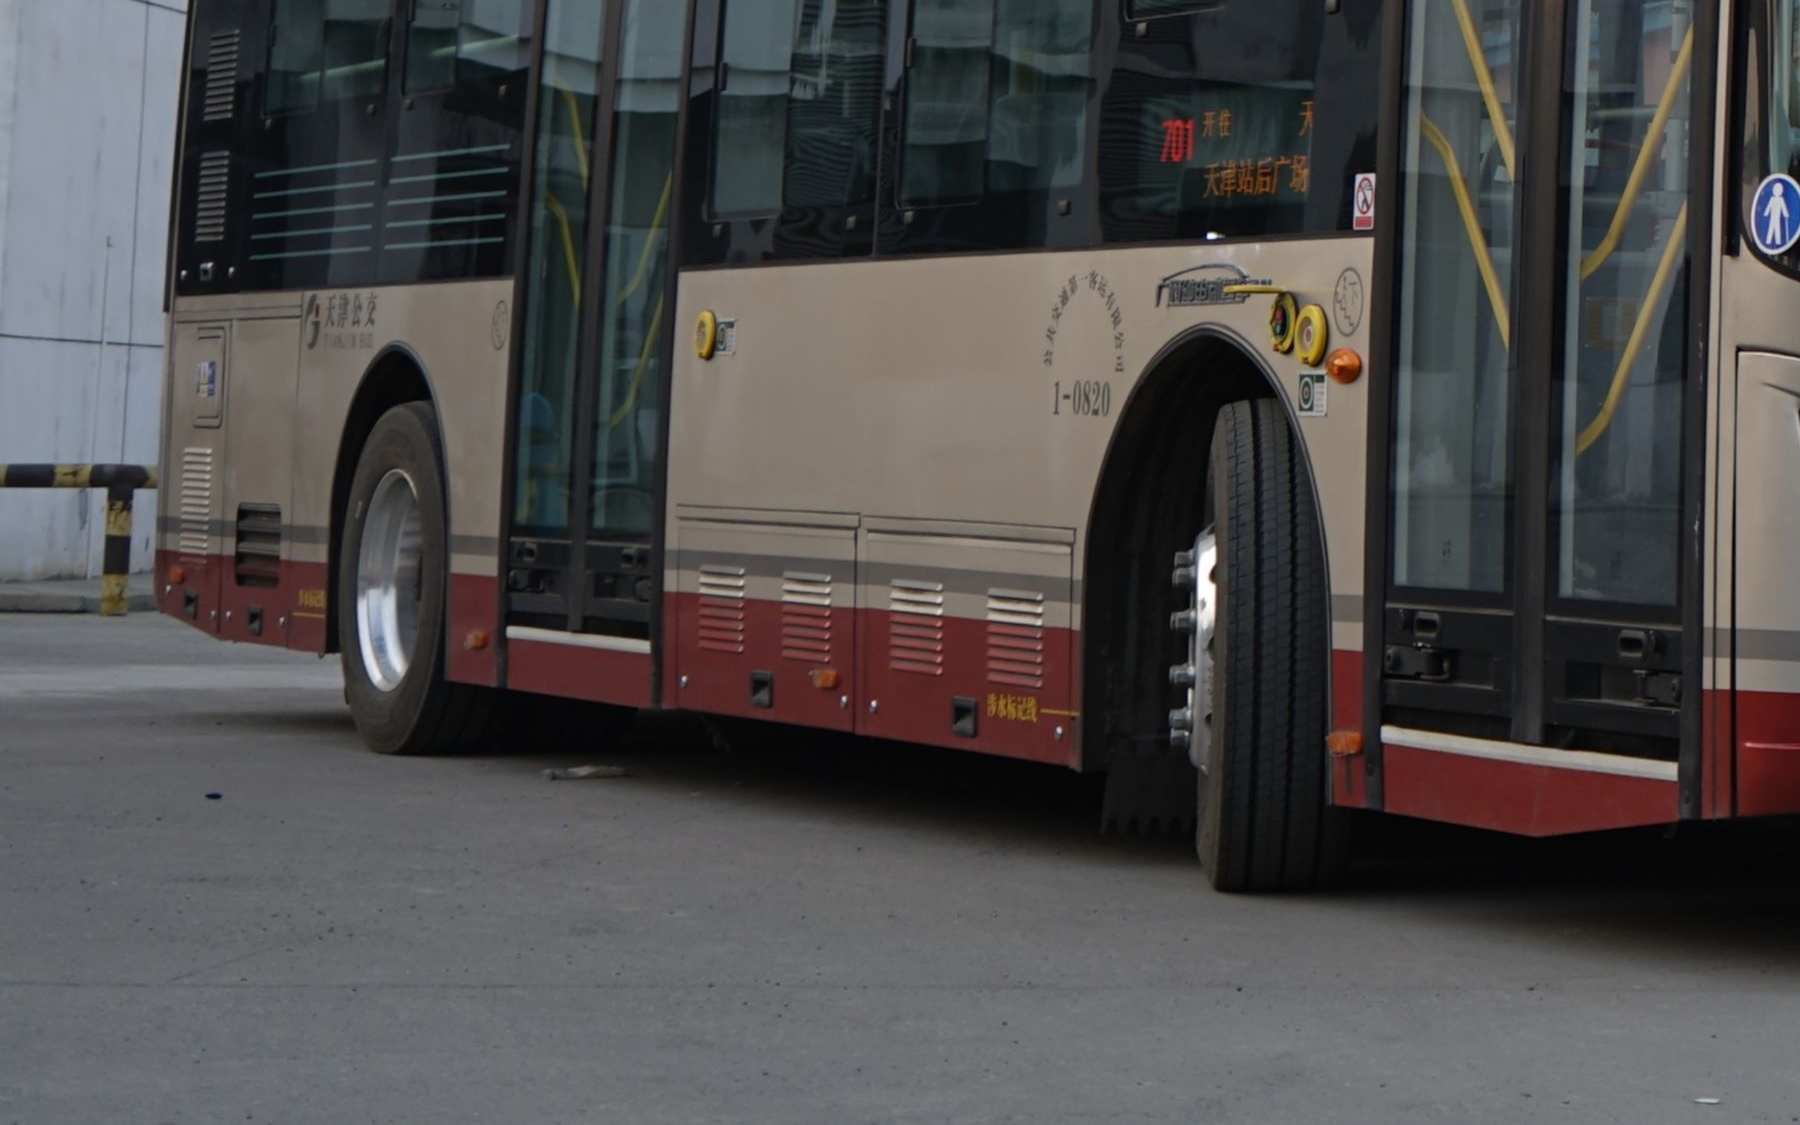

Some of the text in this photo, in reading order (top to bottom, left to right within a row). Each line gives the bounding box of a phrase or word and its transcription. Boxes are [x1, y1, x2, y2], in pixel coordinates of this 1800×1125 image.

[1160, 118, 1195, 162] 701
[1203, 108, 1233, 138] 开往
[1203, 154, 1310, 199] 天津站后广场
[324, 291, 377, 329] 天津公交
[1052, 380, 1111, 417] 1-0820
